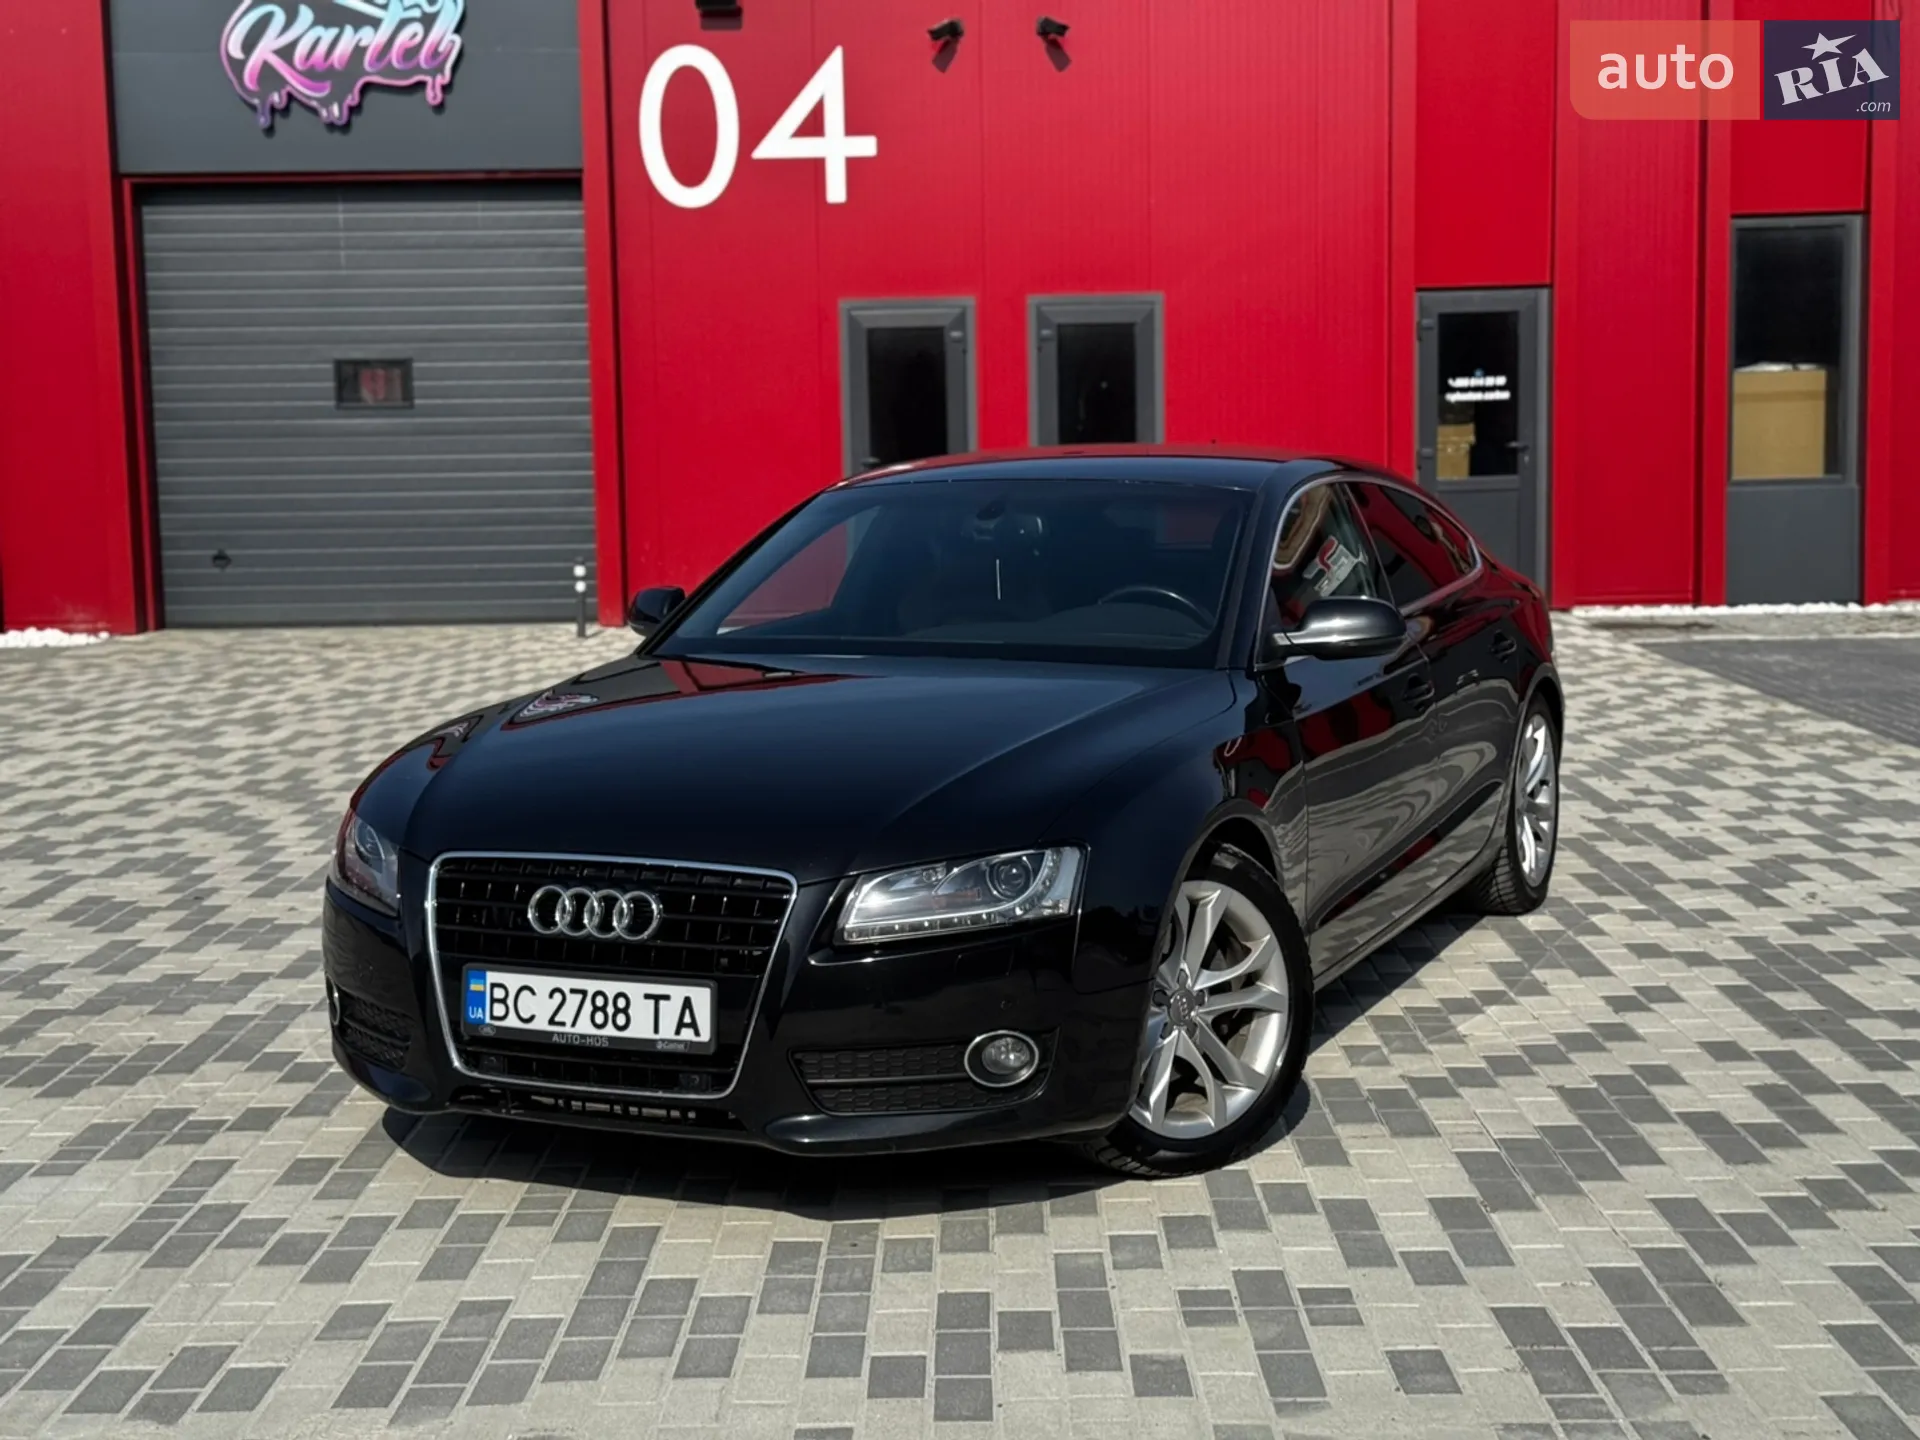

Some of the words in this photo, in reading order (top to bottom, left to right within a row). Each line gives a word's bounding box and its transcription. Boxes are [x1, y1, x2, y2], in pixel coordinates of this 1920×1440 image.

[227, 0, 457, 97] Kartel
[638, 43, 878, 209] 04
[469, 1005, 484, 1019] UA
[489, 982, 537, 1024] BC
[548, 986, 631, 1032] 2788
[643, 993, 701, 1038] TA
